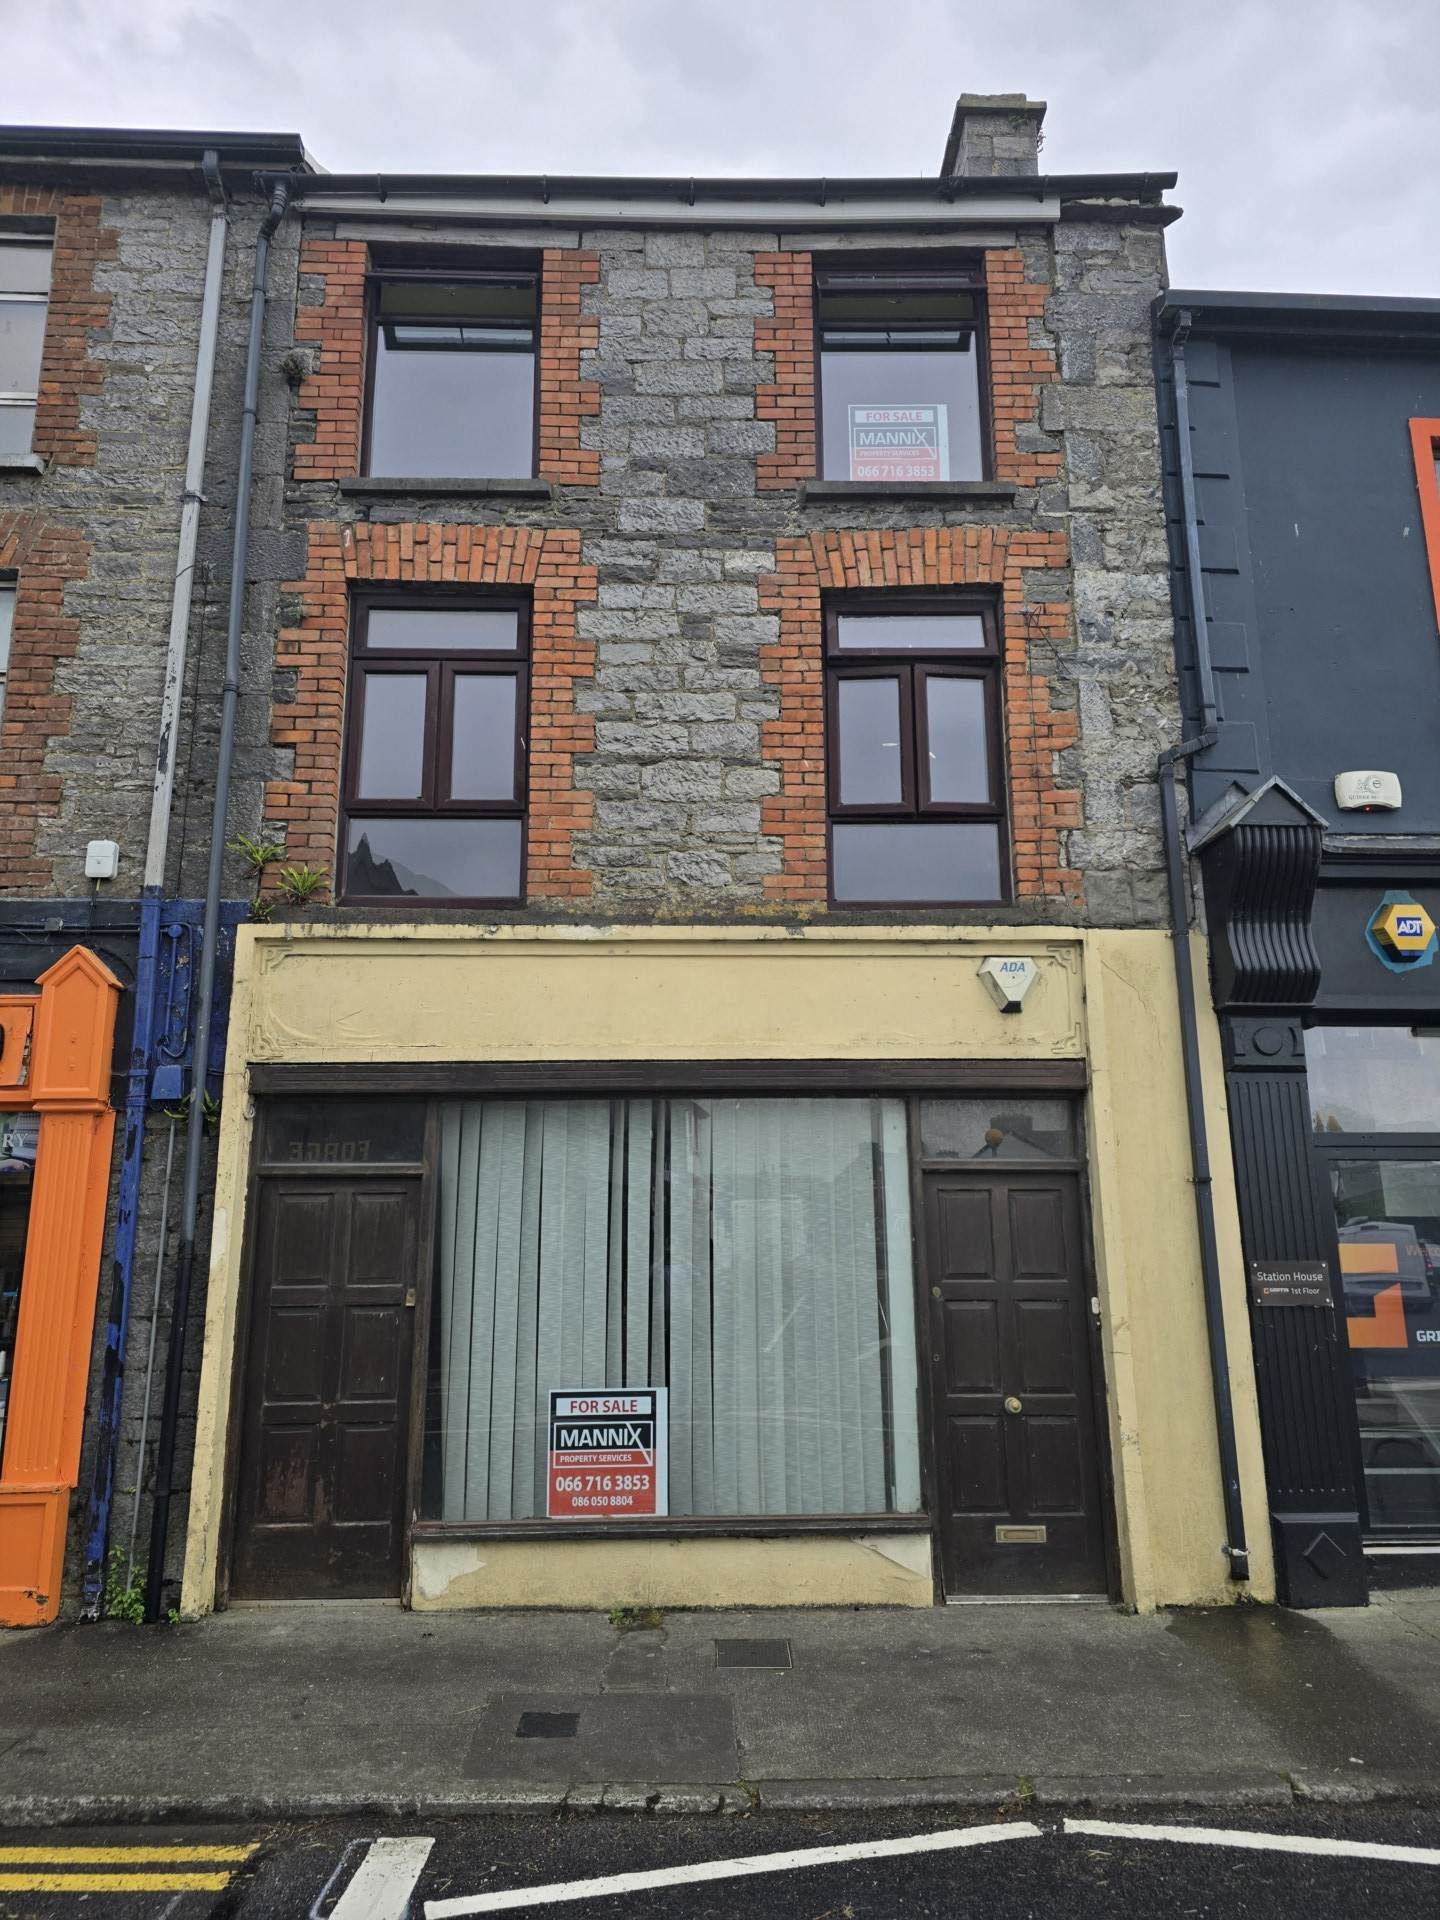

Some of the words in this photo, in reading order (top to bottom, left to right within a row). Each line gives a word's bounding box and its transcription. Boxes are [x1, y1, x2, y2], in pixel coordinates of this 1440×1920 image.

[866, 411, 890, 421] FOR
[893, 411, 923, 421] SALE
[860, 430, 927, 446] MANNIX
[857, 465, 880, 477] 066
[881, 465, 904, 477] 716
[905, 465, 935, 477] 3853
[1397, 919, 1423, 934] ADT
[1000, 962, 1025, 972] ADA
[1256, 1271, 1291, 1281] Station
[1293, 1271, 1323, 1281] House
[1291, 1287, 1302, 1295] 1st
[1302, 1287, 1320, 1295] Floor
[570, 1400, 598, 1413] FOR
[603, 1399, 638, 1413] SALE
[560, 1427, 642, 1448] MANNIX
[560, 1455, 597, 1463] PROPERTY
[598, 1454, 632, 1462] SERVICES
[555, 1476, 583, 1491] 066
[585, 1475, 612, 1491] 716
[615, 1475, 650, 1491] 3853
[572, 1496, 589, 1507] 086
[591, 1496, 608, 1506] 050
[610, 1495, 633, 1506] 8804
